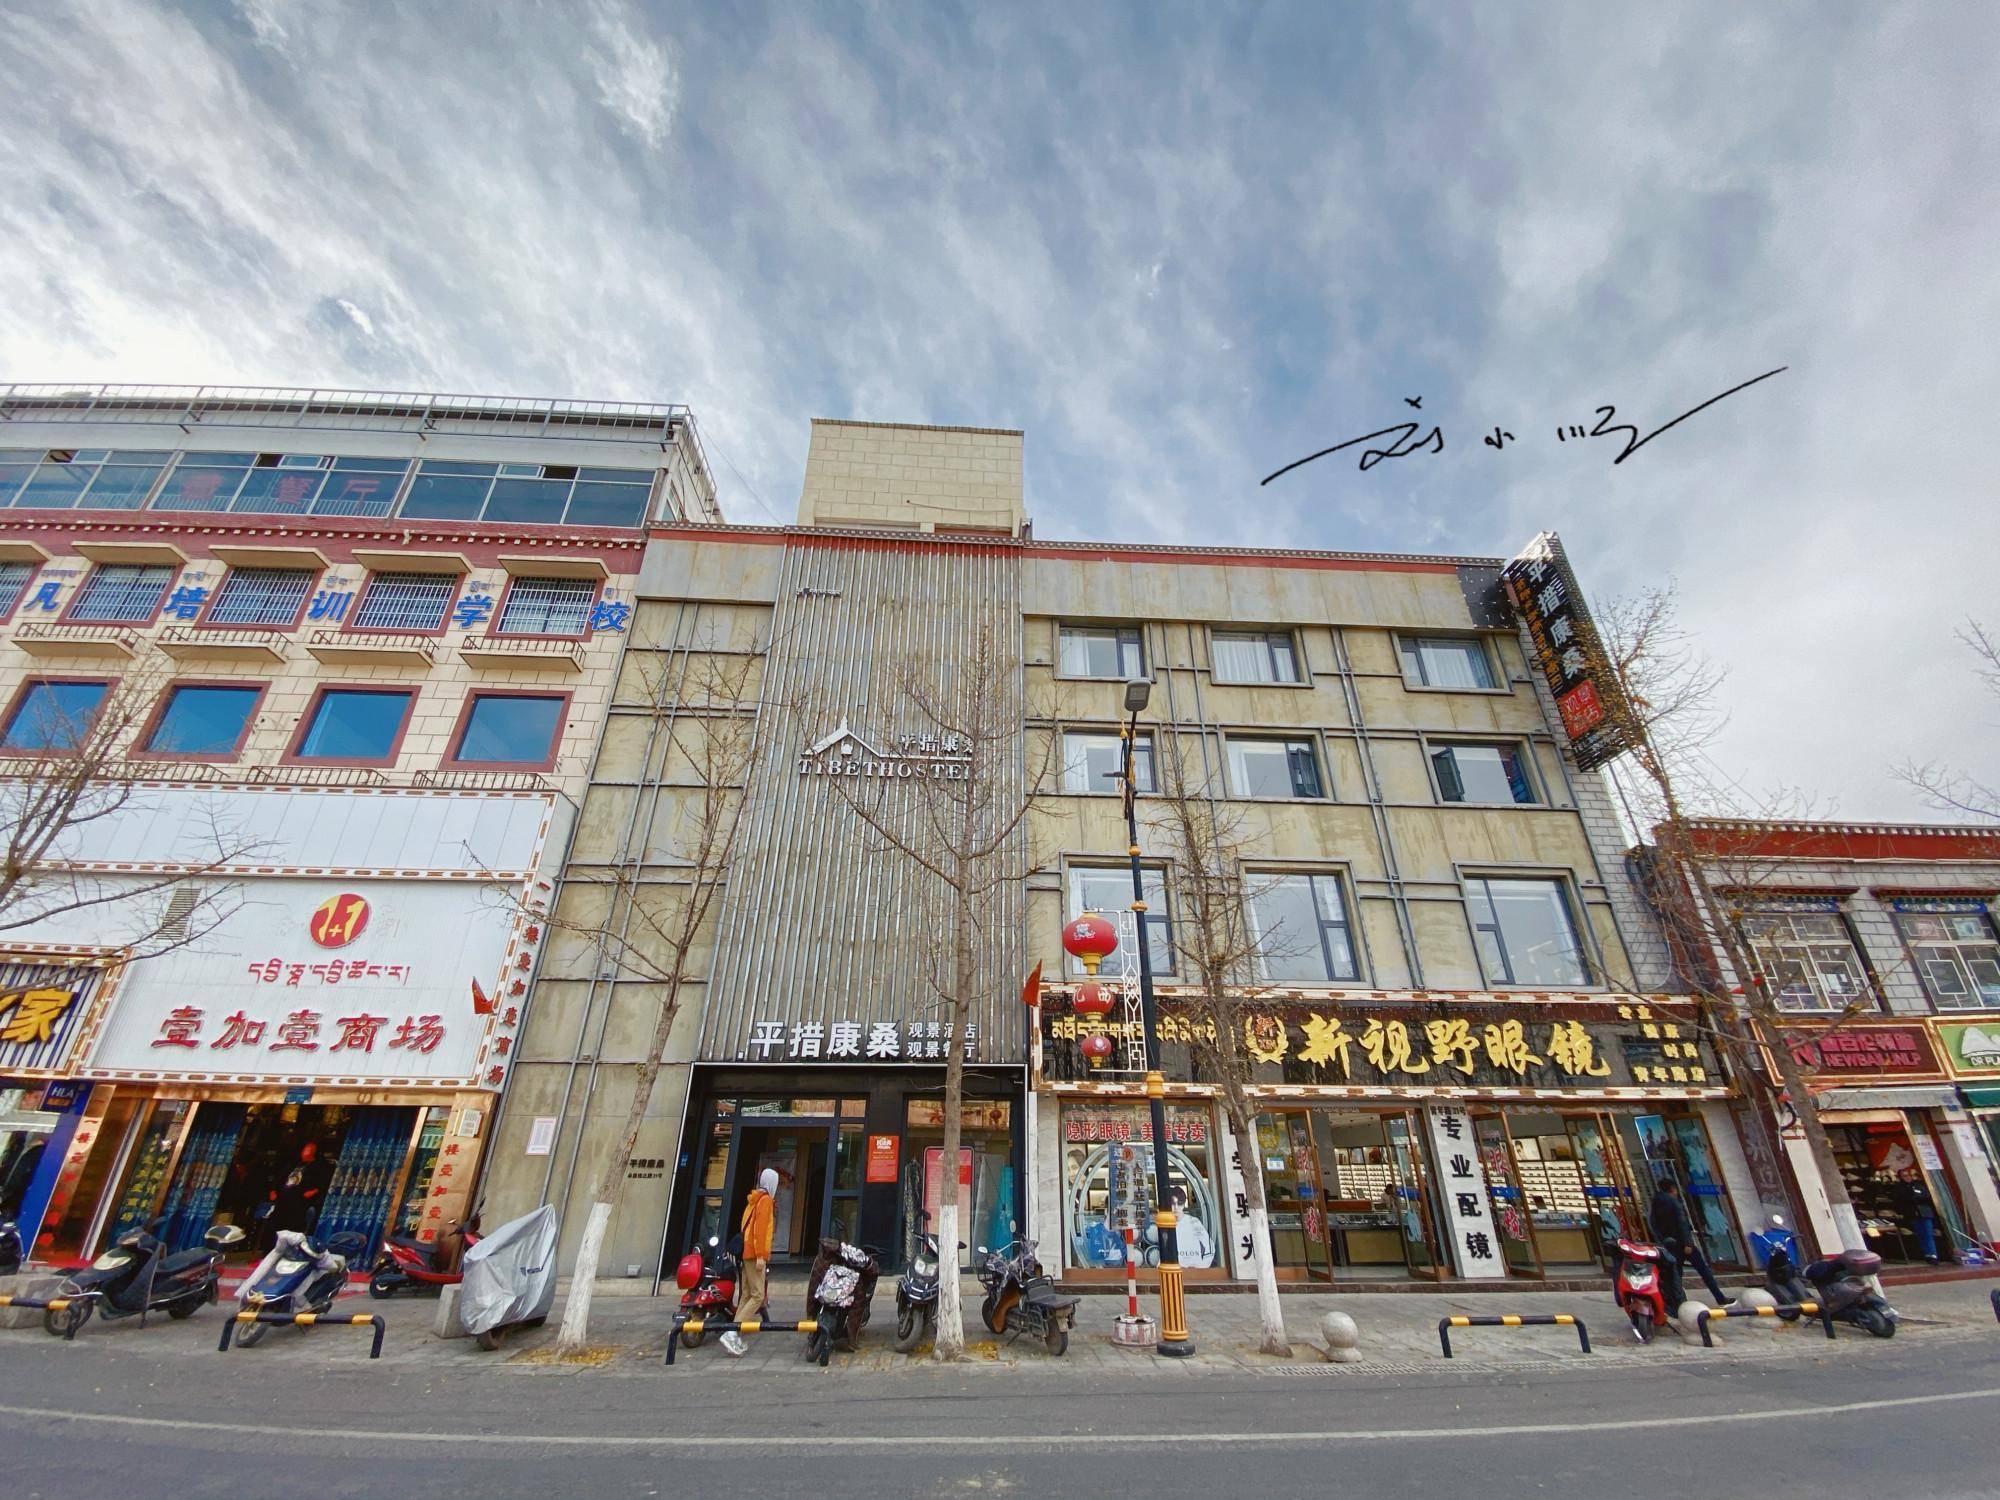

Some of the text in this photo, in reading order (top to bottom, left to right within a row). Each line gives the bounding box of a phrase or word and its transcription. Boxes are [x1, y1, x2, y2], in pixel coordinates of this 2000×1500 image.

[1528, 556, 1587, 680] 平措康桑
[151, 1005, 446, 1055] 壹加壹商场
[750, 1019, 901, 1058] 平措康桑
[1297, 1012, 1612, 1079] 新视野眼镜
[1066, 1121, 1131, 1141] 隐形眼镜
[1440, 1115, 1493, 1260] 专业配镜
